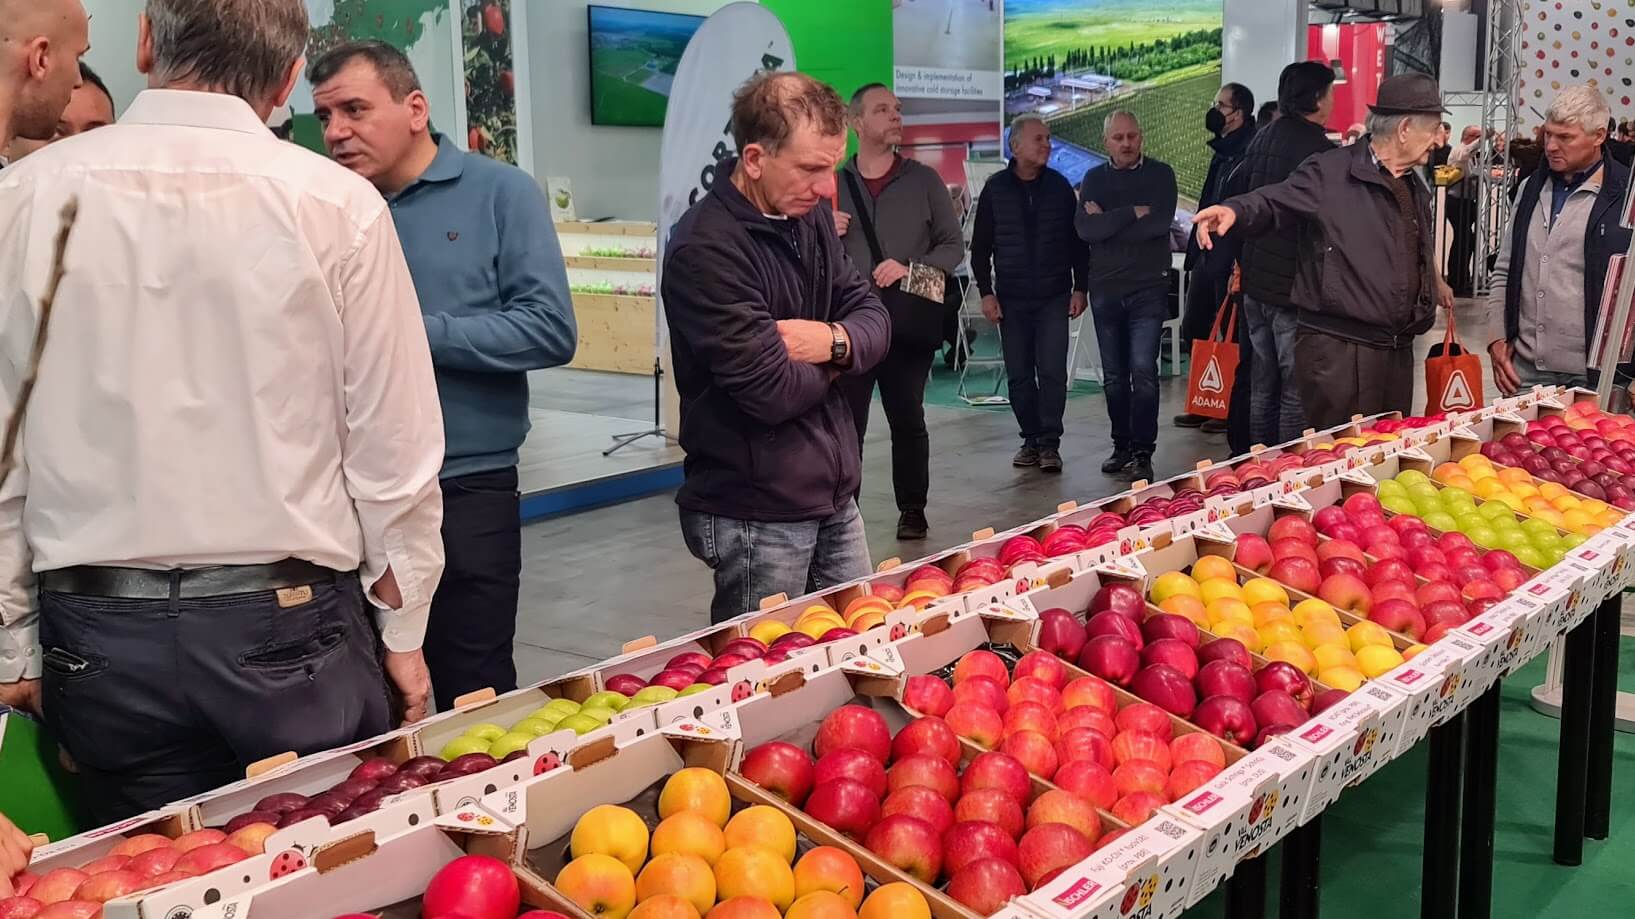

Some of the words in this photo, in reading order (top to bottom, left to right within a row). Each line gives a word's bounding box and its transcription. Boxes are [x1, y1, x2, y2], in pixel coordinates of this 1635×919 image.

[895, 69, 916, 82] Design
[917, 71, 922, 80] &
[924, 72, 964, 82] implementation
[1191, 395, 1226, 410] ADAMA
[1341, 751, 1372, 779] VENOSTA
[1234, 815, 1273, 853] VENOSTA
